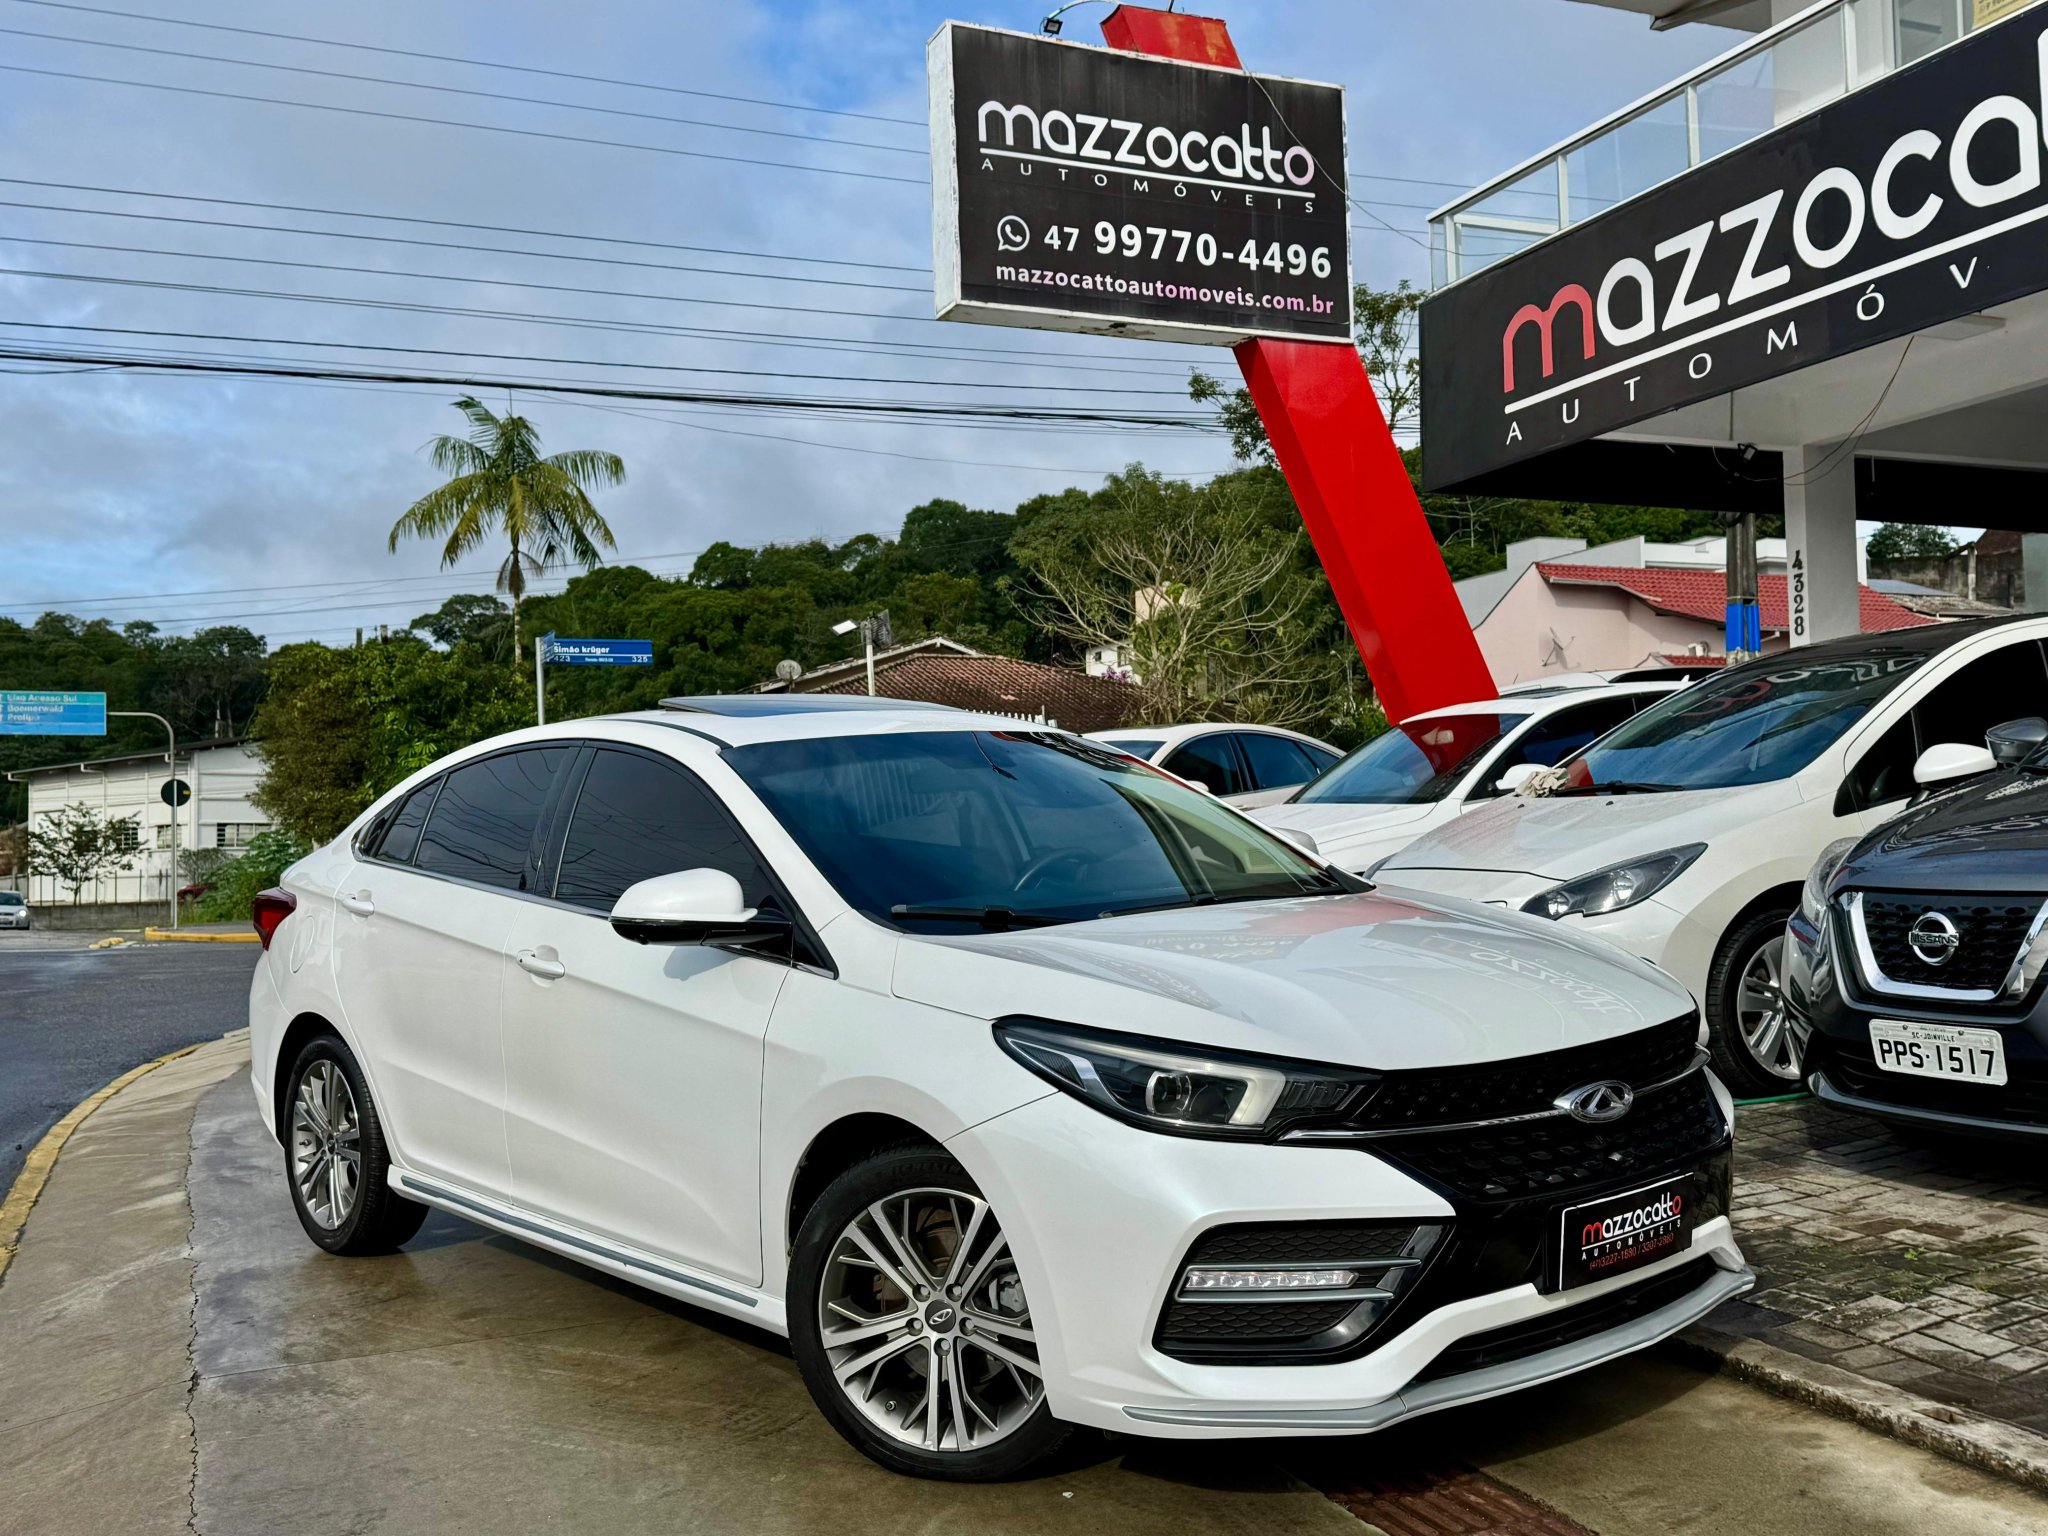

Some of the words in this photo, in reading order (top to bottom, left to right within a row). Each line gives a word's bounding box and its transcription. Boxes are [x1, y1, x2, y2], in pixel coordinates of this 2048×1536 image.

[978, 100, 1315, 186] mazzocatto
[981, 157, 1314, 214] AUTOMÓVEIS
[1044, 225, 1079, 252] 47
[1094, 221, 1332, 278] 99770-4496
[996, 264, 1334, 315] mazzocattoautomoveis.com.br
[1792, 550, 1804, 636] 4328
[1582, 1221, 1681, 1260] AUTOMÓVEIS
[1583, 1192, 1682, 1245] mazzocatto
